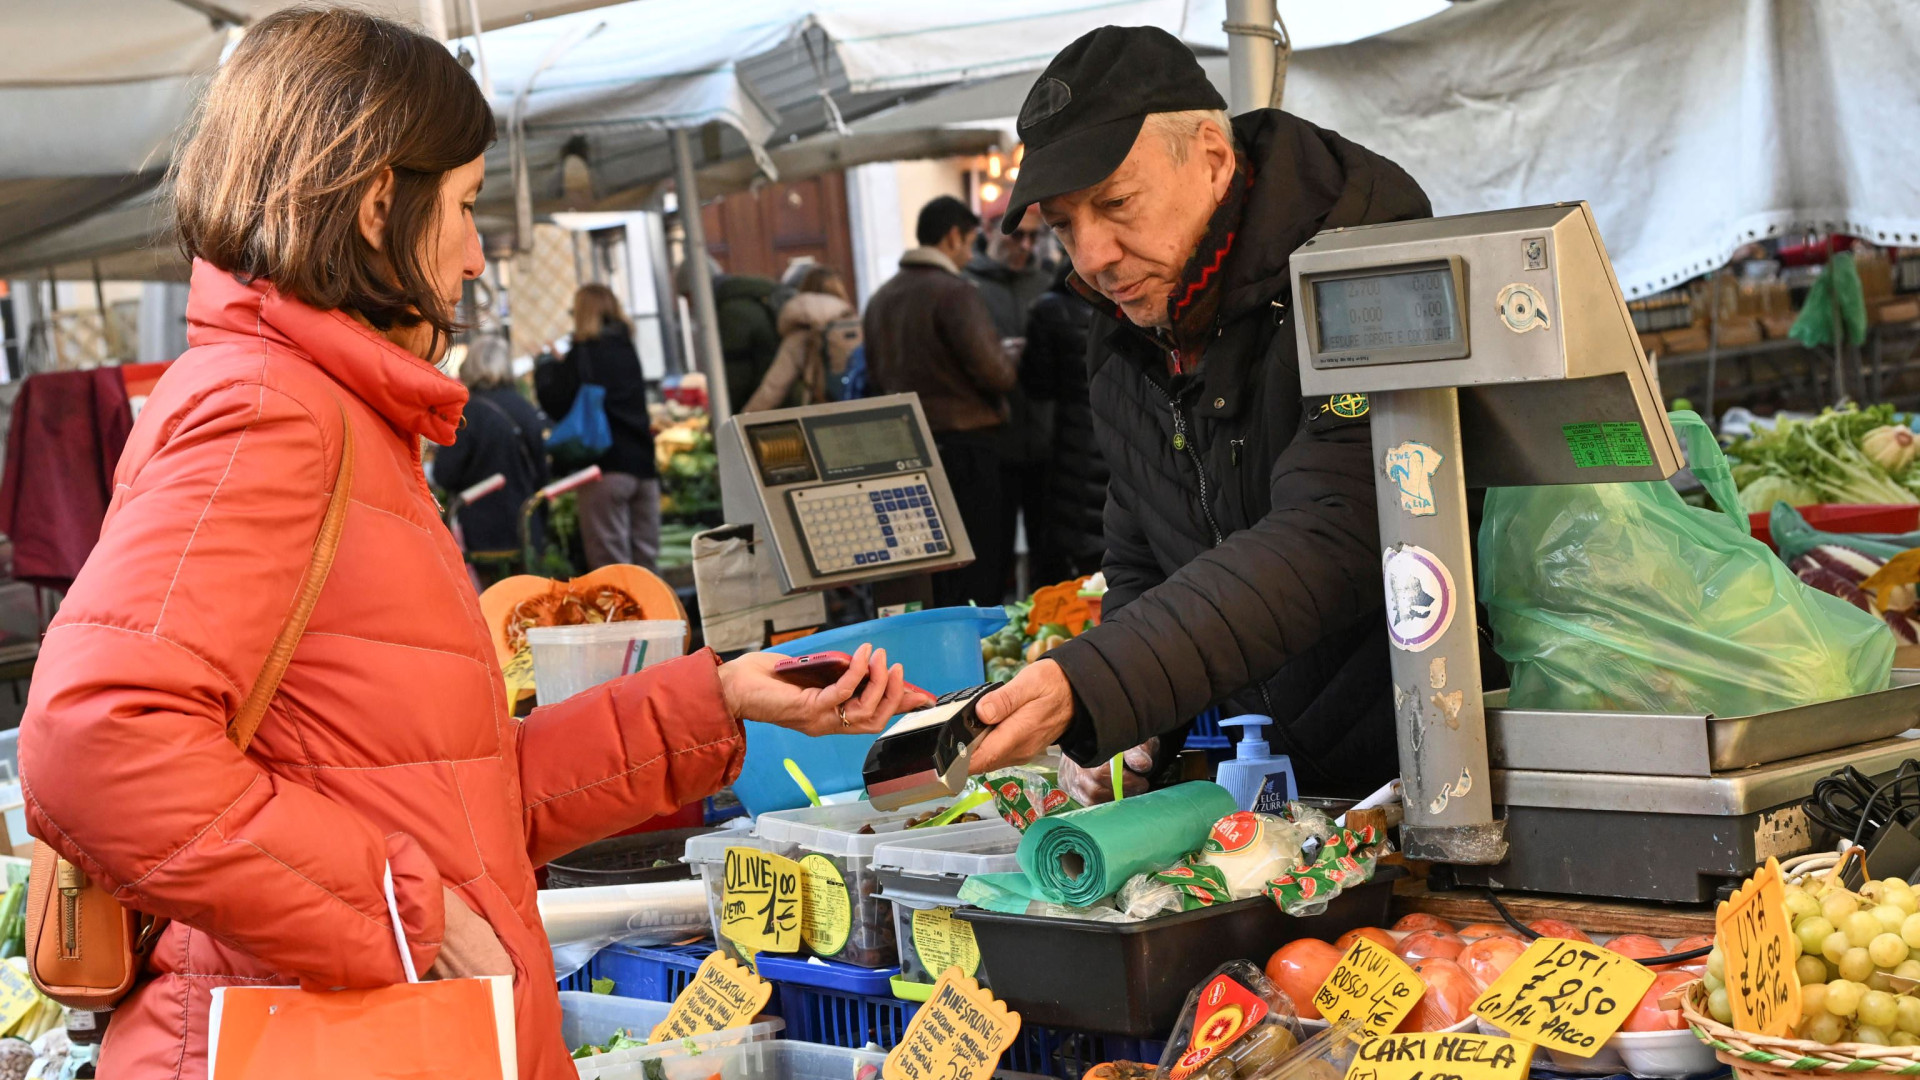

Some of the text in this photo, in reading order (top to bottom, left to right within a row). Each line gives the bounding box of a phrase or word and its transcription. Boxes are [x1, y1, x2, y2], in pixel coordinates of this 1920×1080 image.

[1260, 792, 1281, 803] ELCE
[725, 850, 772, 890] OLIVE
[1737, 890, 1767, 959] UVA
[1348, 940, 1391, 978] KIWI
[704, 966, 745, 1004] INSALATINA
[1331, 966, 1368, 998] ROSSO
[937, 984, 994, 1040] MINESTRONE
[924, 1021, 946, 1045] CAROTE
[1537, 1015, 1596, 1048] PACCO
[1359, 1037, 1517, 1068] CAKI MELA
